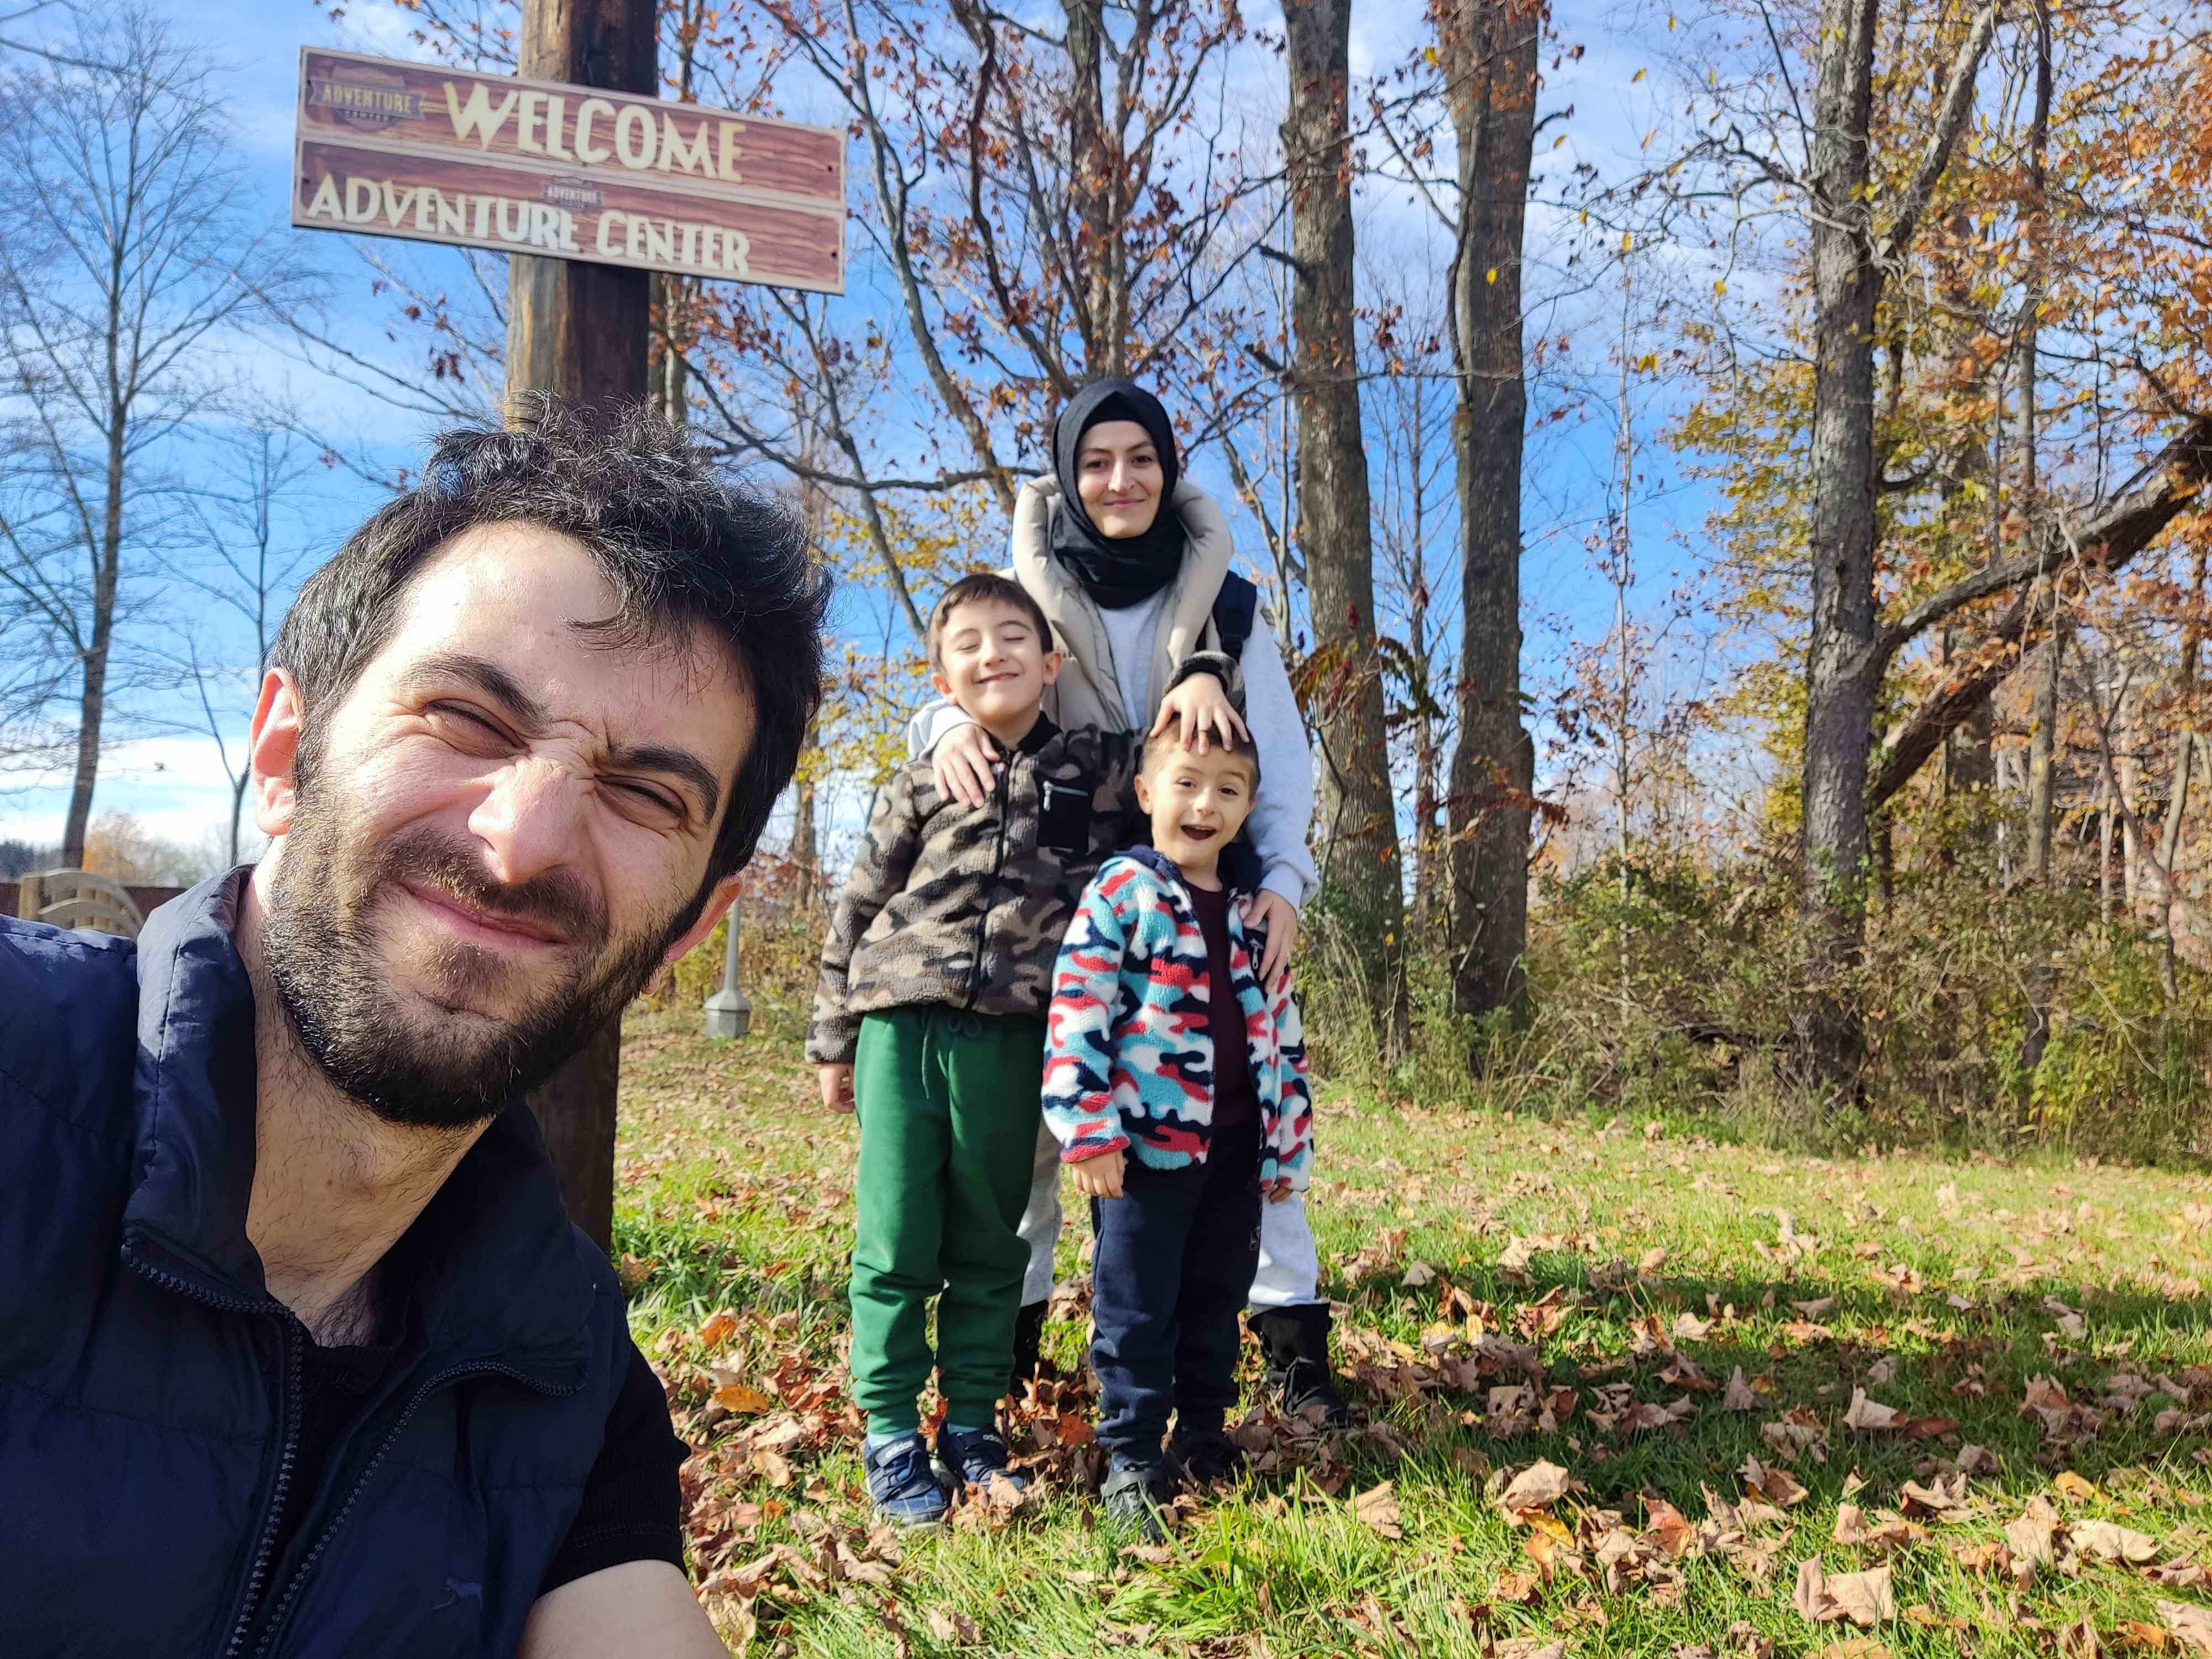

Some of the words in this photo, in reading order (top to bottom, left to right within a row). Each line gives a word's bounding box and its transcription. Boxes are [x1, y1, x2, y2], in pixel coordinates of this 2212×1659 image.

[322, 84, 413, 113] ADVENTURE
[444, 81, 747, 182] WELCOME
[306, 173, 580, 252] ADVENTURE
[597, 209, 750, 275] CENTER
